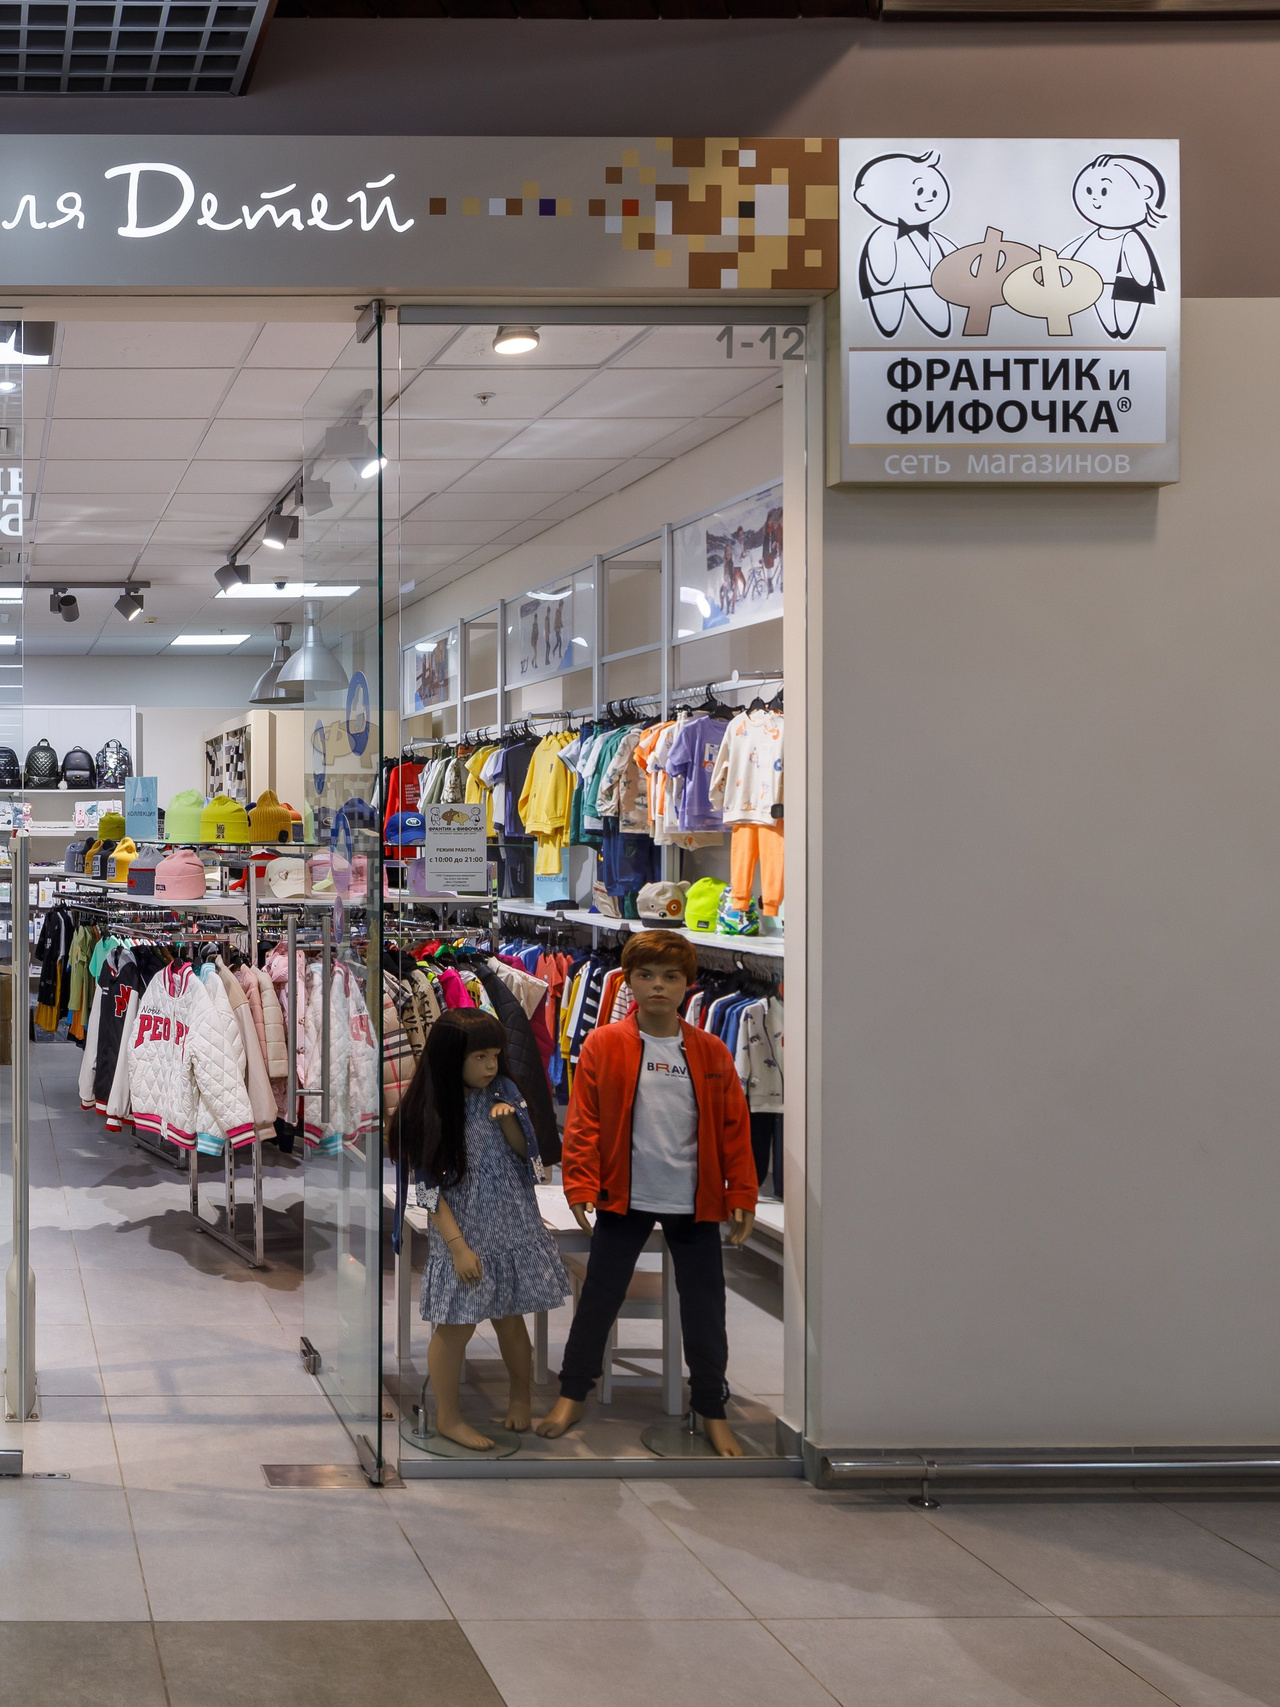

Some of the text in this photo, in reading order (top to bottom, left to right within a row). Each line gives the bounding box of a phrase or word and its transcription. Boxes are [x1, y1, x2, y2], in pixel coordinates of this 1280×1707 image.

[104, 161, 415, 237] Детей
[715, 325, 805, 361] 1-12
[886, 356, 1131, 393] ФРАНТИК и
[884, 454, 1131, 474] сеть магазинов
[646, 1061, 687, 1076] BRAV
